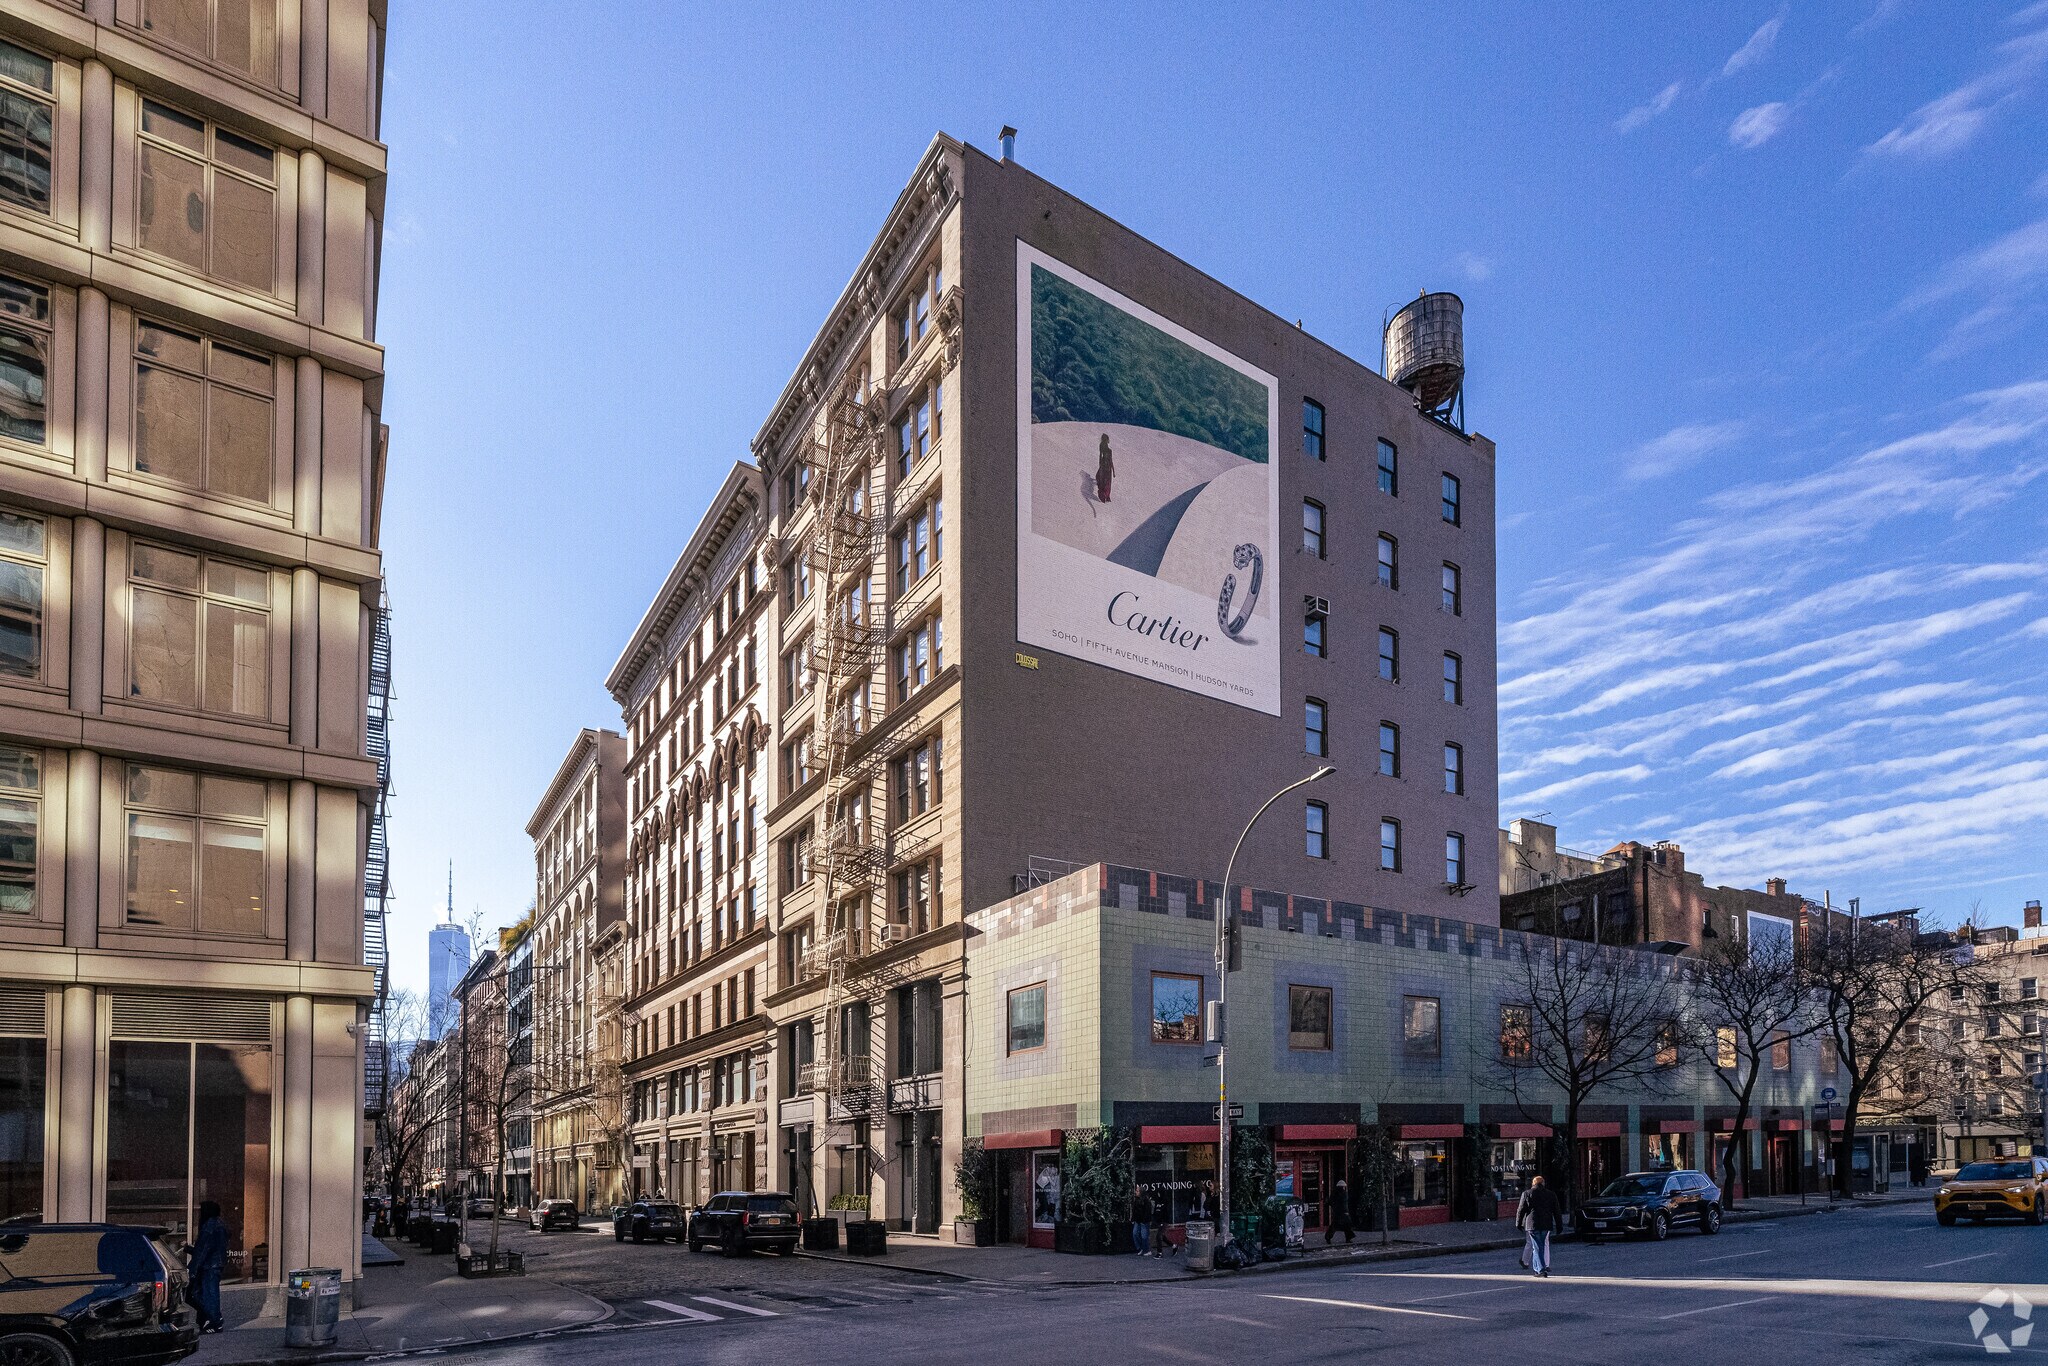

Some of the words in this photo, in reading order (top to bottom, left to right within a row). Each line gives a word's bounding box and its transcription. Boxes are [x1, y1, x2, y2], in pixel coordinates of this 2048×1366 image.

[1107, 591, 1209, 651] Cartier
[1052, 629, 1078, 643] SOHO
[1086, 640, 1113, 654] FIFTH
[1115, 648, 1149, 665] AVENUE
[1151, 659, 1189, 677] MANSION
[1196, 673, 1228, 688] HUDSON
[1229, 683, 1254, 697] YARDS
[1151, 1180, 1193, 1192] STANDING
